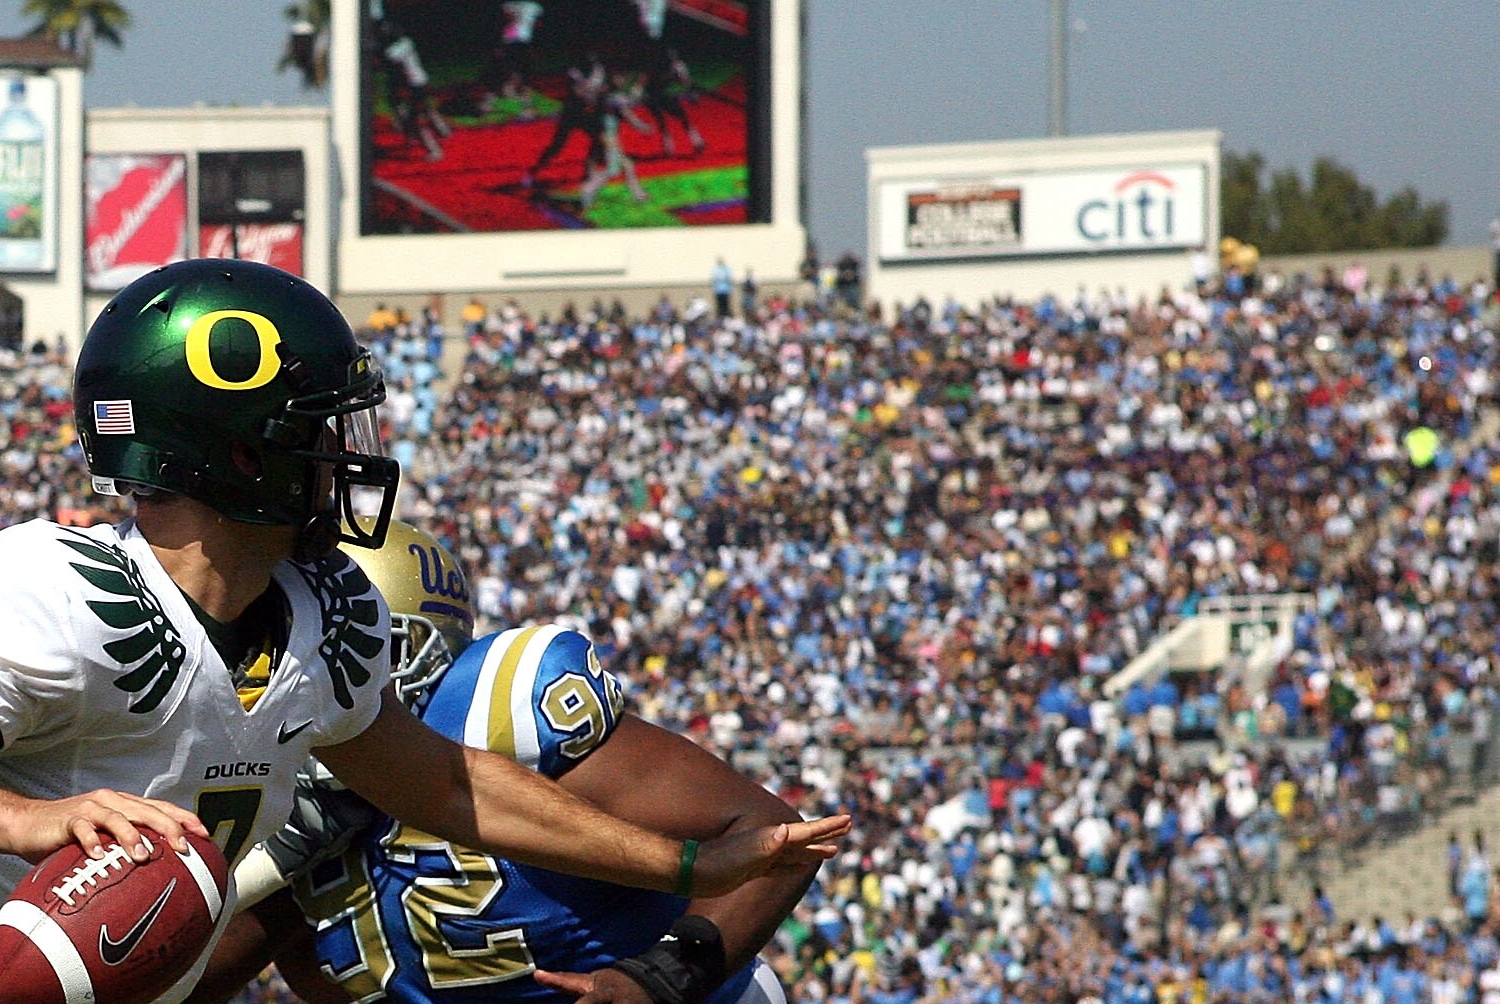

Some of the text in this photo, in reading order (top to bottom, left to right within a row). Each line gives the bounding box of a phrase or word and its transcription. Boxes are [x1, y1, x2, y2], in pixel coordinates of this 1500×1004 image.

[1076, 187, 1174, 242] citi
[185, 310, 283, 390] O
[204, 761, 272, 780] DUCKS
